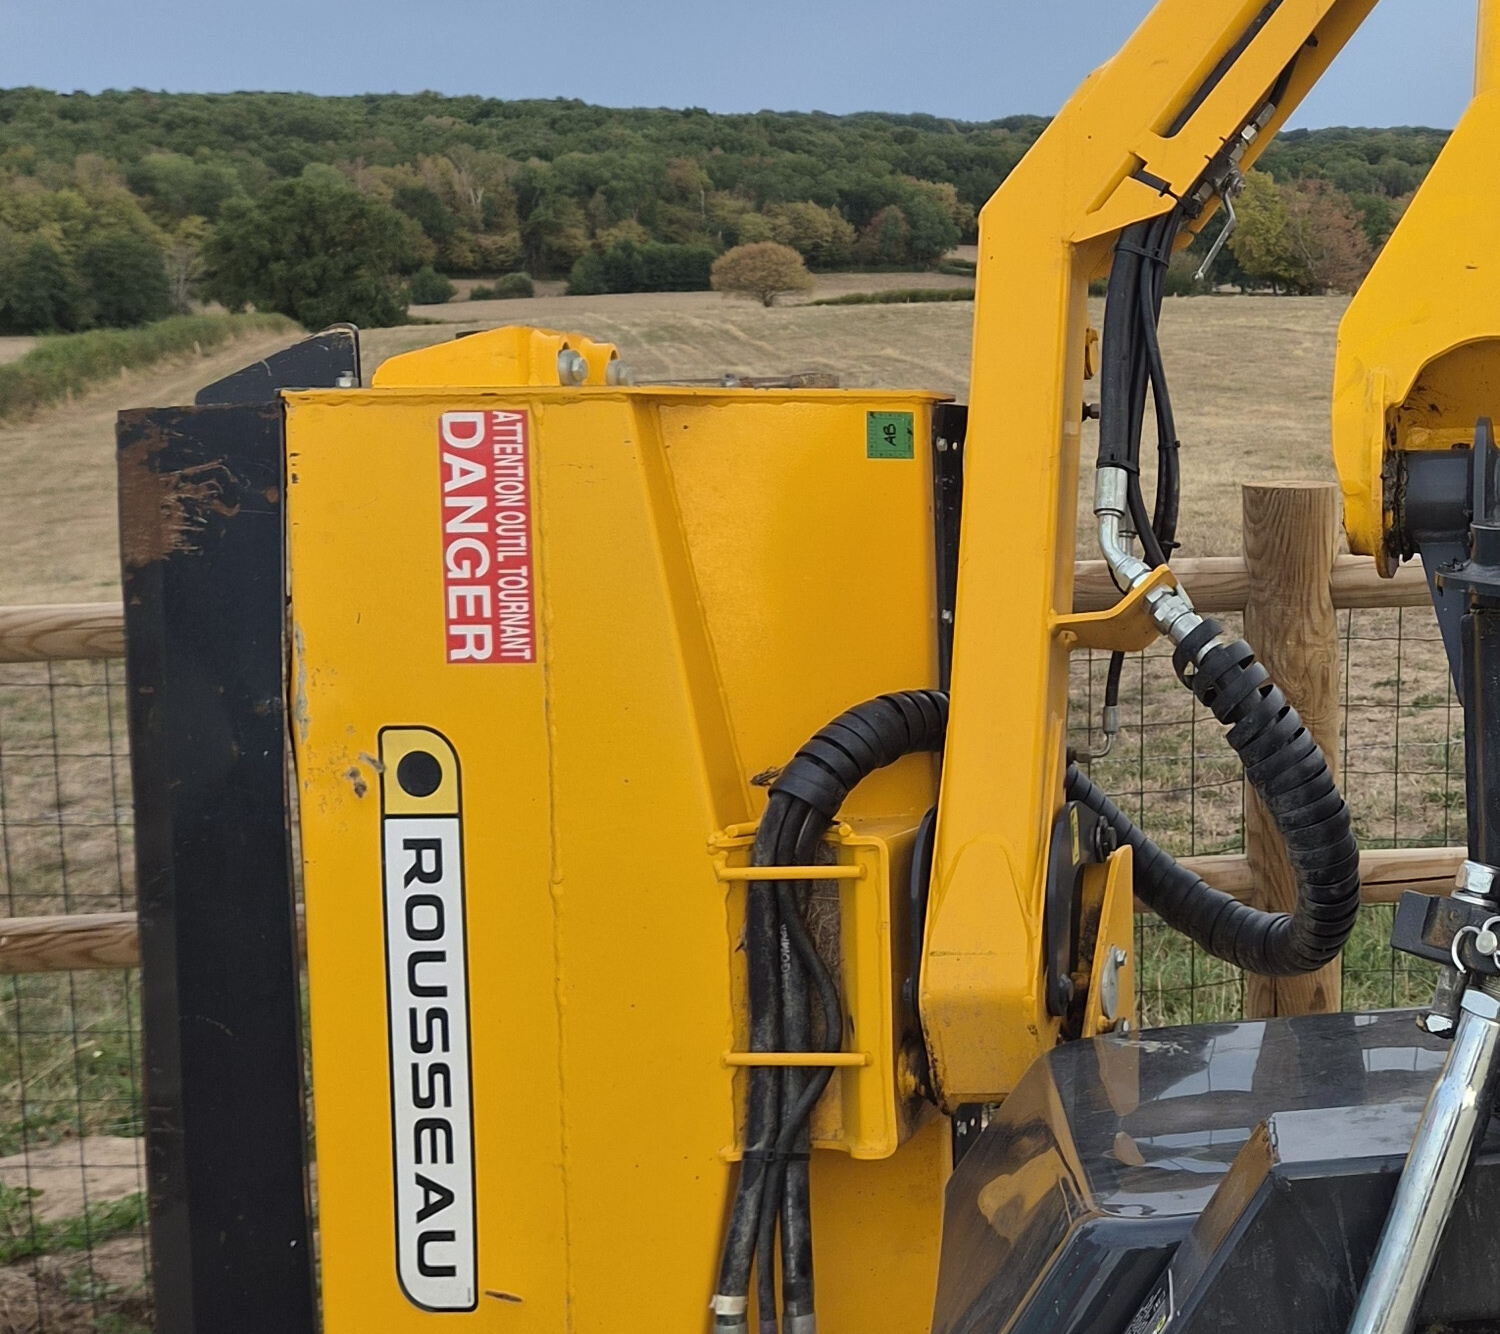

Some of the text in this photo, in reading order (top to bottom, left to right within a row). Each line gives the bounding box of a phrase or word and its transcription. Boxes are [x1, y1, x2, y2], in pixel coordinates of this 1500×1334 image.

[441, 411, 493, 661] DANGER
[492, 410, 531, 660] ATTENTION OUTIL TOURNANT
[401, 836, 457, 1279] ROUSSEAU
